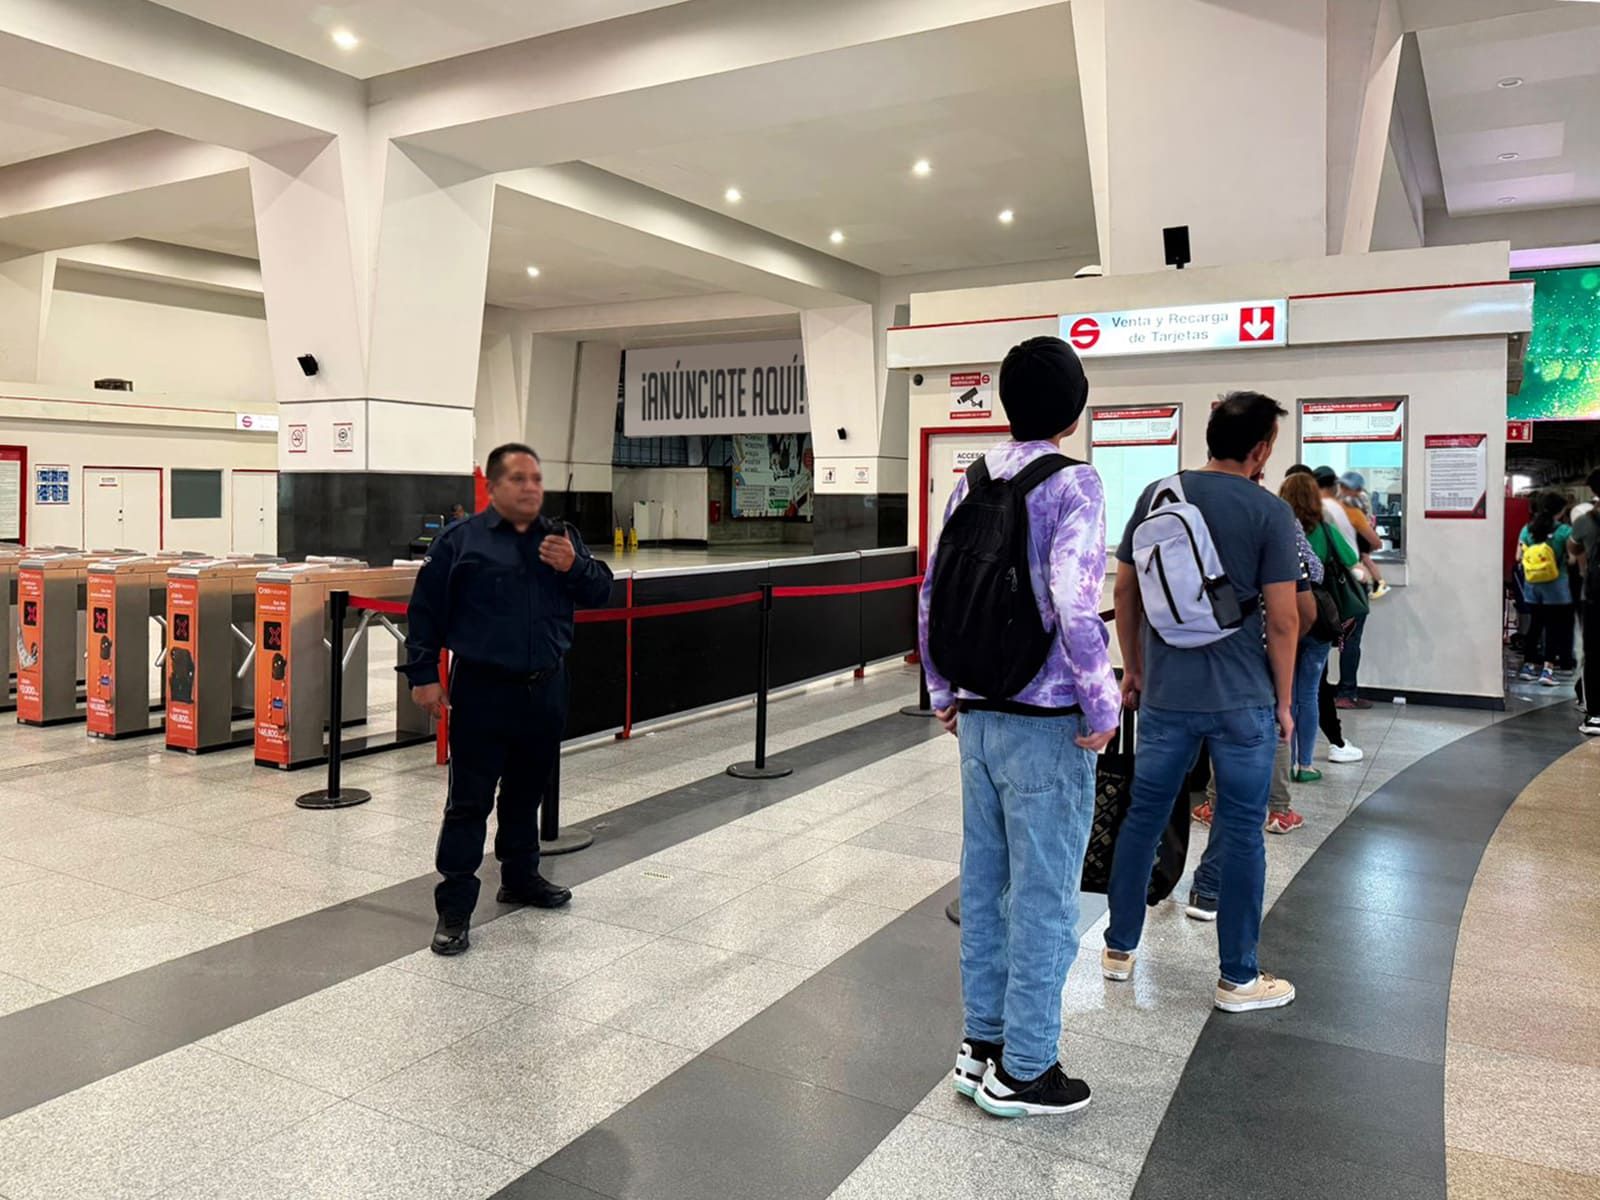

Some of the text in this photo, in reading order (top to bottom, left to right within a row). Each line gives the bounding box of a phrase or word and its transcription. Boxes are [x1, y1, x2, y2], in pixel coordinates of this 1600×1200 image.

[1112, 312, 1229, 328] Venta y Recarga
[1128, 330, 1209, 344] de Tarjetas
[641, 353, 805, 421] ¡ANÚNCIATE AQUÍ!
